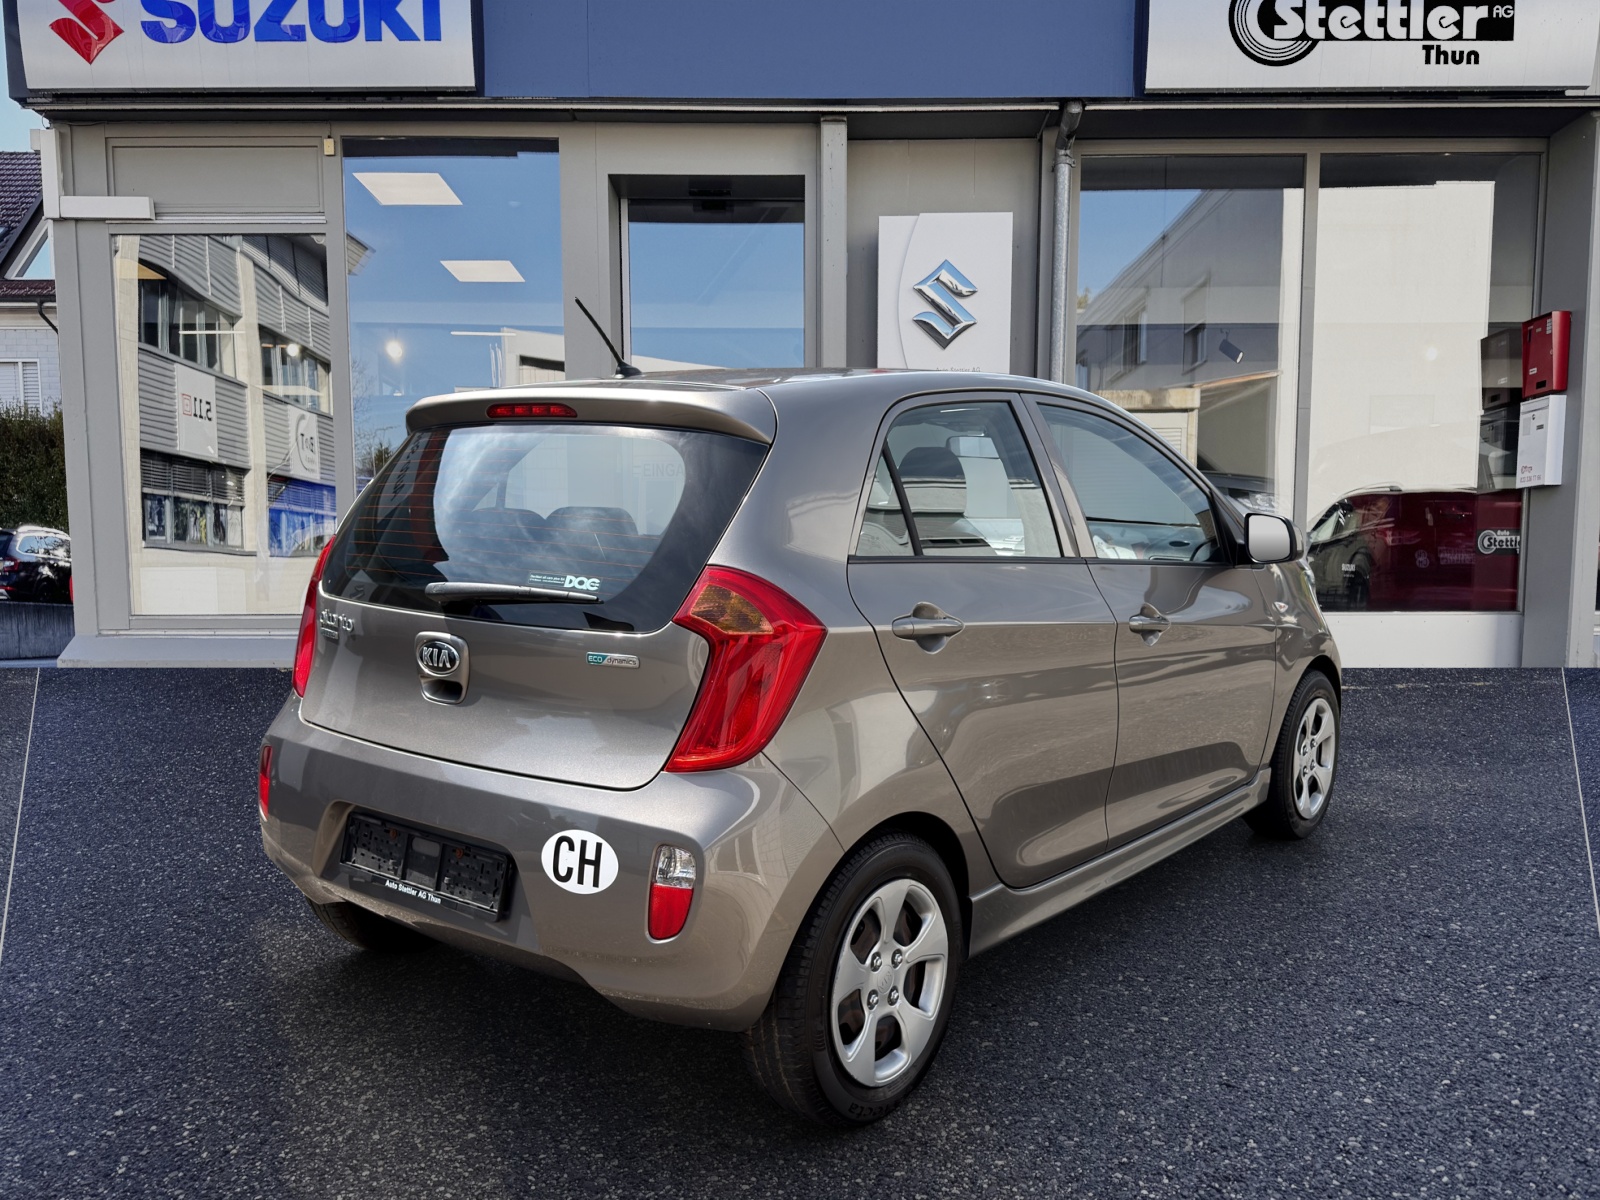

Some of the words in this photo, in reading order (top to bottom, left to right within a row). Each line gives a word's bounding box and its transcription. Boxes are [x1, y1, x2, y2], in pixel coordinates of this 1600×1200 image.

[139, 0, 441, 43] SUZUKI
[1274, 0, 1488, 40] Stettler
[1493, 5, 1514, 18] AG
[1422, 44, 1480, 65] Thun
[422, 646, 451, 668] KIA
[588, 655, 603, 663] ECO
[552, 835, 603, 889] CH
[385, 879, 398, 890] Auto
[398, 883, 417, 896] Stettler
[417, 890, 427, 899] AG
[428, 892, 442, 904] Thun
